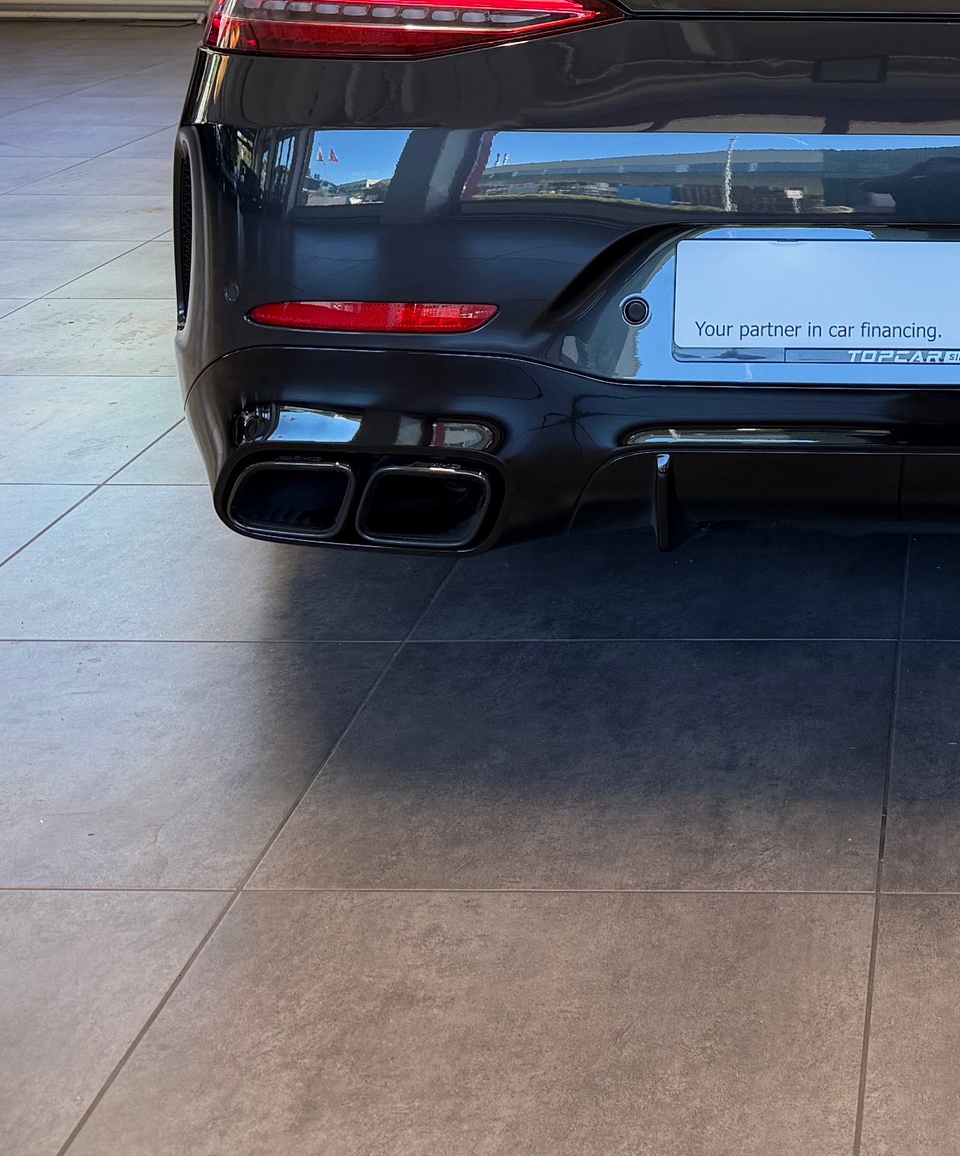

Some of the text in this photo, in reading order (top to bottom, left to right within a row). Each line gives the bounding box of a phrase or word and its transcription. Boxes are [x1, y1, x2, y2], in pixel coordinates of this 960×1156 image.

[695, 321, 942, 342] Your partner in car financing.
[848, 350, 944, 363] TOPCAR
